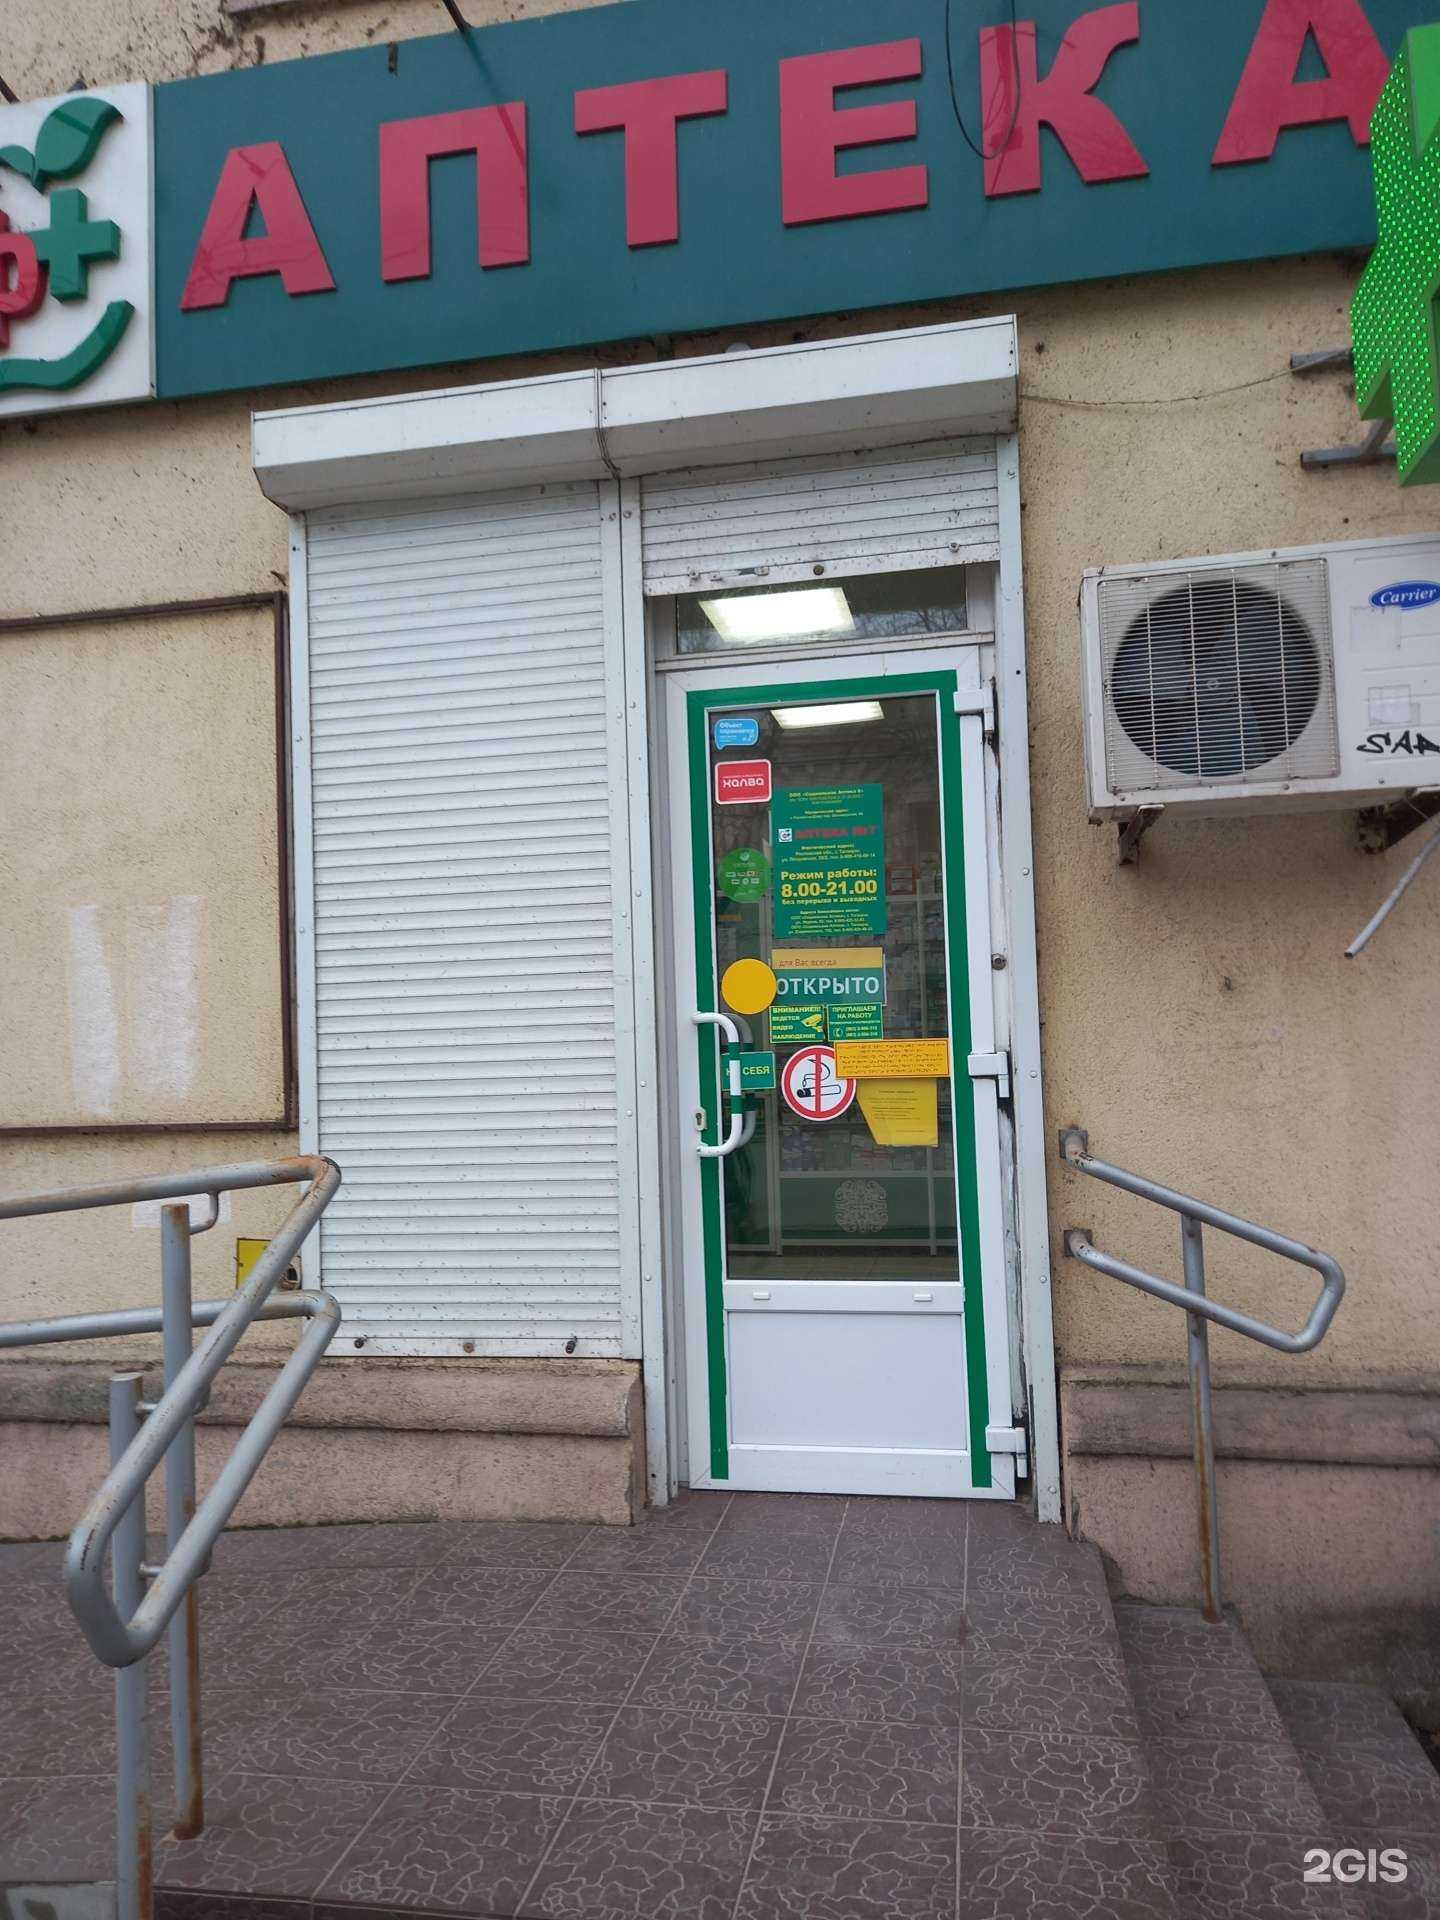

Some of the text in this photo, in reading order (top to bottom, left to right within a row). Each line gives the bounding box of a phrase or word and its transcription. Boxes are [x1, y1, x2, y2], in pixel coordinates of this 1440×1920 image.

[179, 0, 1393, 311] АПТЕКА
[1380, 588, 1437, 605] Carrier
[781, 868, 877, 881] Режим работы:
[781, 880, 878, 898] 8.00-21.00
[776, 976, 880, 995] ОТКРЫТО
[742, 1066, 770, 1076] СЕБЯ
